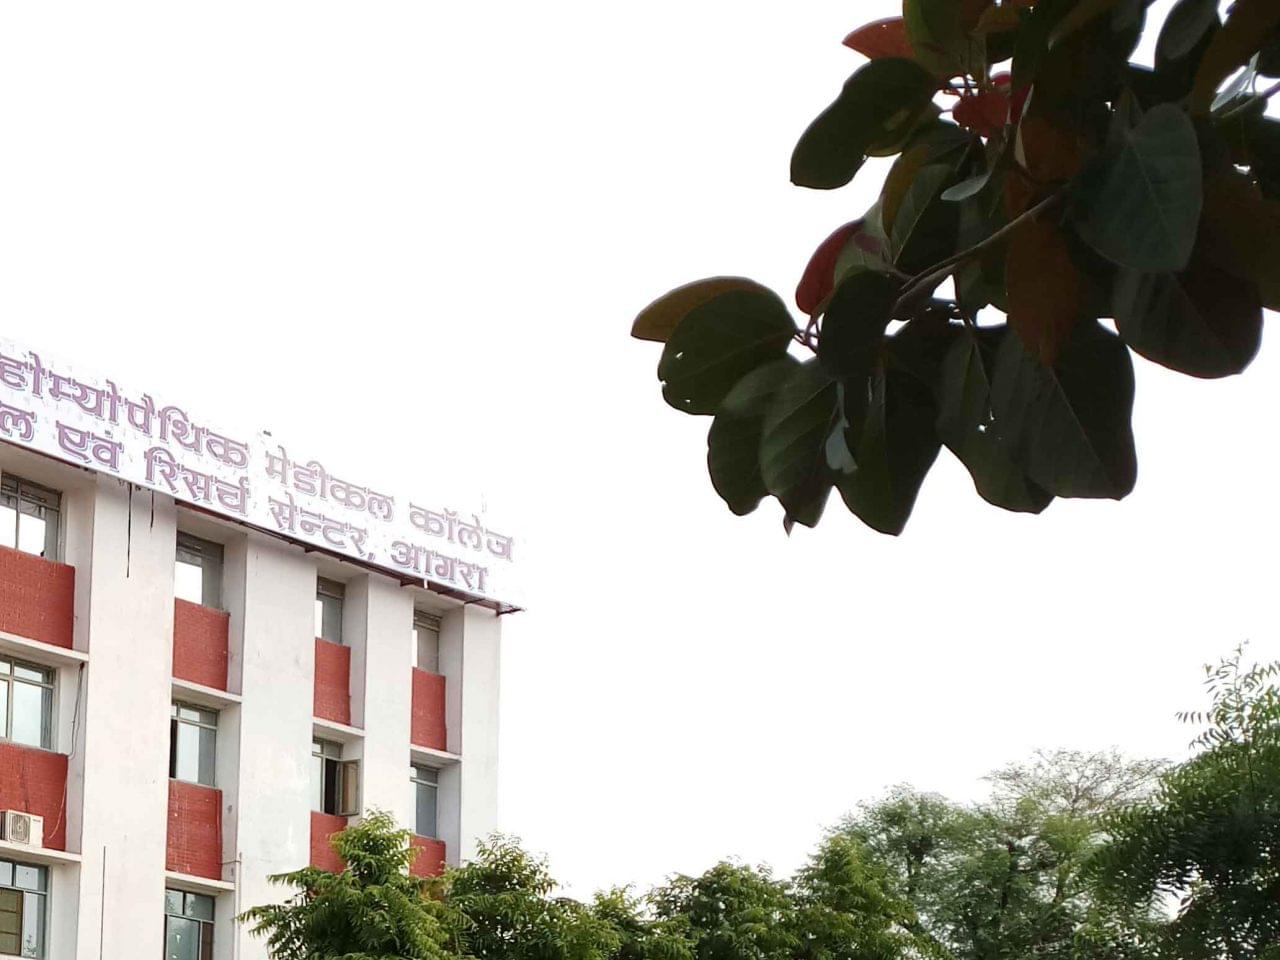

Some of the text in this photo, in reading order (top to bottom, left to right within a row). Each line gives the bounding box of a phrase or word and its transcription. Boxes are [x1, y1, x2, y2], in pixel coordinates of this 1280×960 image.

[56, 420, 124, 473] एवं
[143, 446, 252, 516] रिसर्च
[391, 541, 490, 593] आगरा
[265, 445, 396, 523] मेडीकल
[409, 502, 515, 563] कॉलेज
